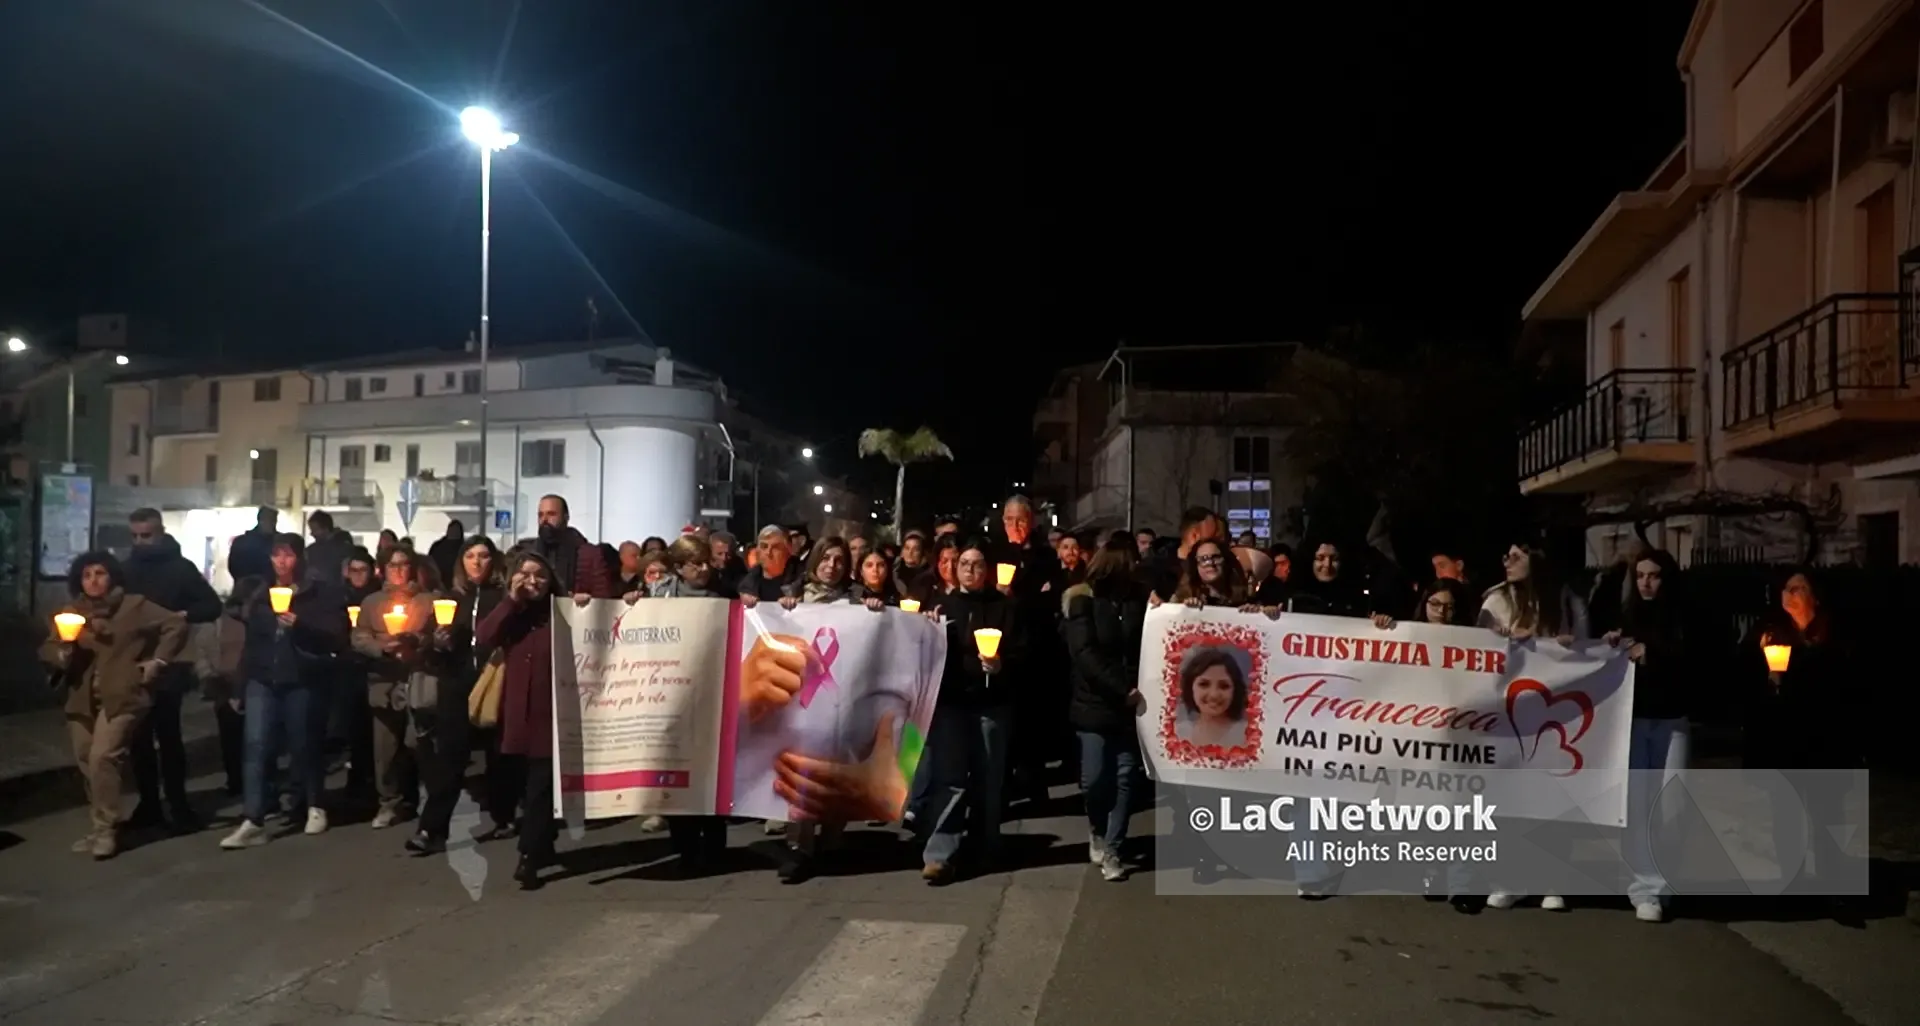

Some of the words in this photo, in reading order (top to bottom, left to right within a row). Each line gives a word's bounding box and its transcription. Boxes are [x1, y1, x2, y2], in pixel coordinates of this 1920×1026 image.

[621, 626, 681, 644] MEDITERRANEA
[1281, 633, 1430, 667] GIUSTIZIA
[1441, 645, 1507, 674] PER
[1273, 673, 1501, 733] Francesca
[1276, 728, 1327, 750] MAI
[1338, 730, 1383, 755] PIÙ
[1392, 738, 1496, 764] VITTIME
[1284, 756, 1314, 777] IN
[1323, 761, 1391, 786] SALA
[1401, 769, 1486, 794] PARTO
